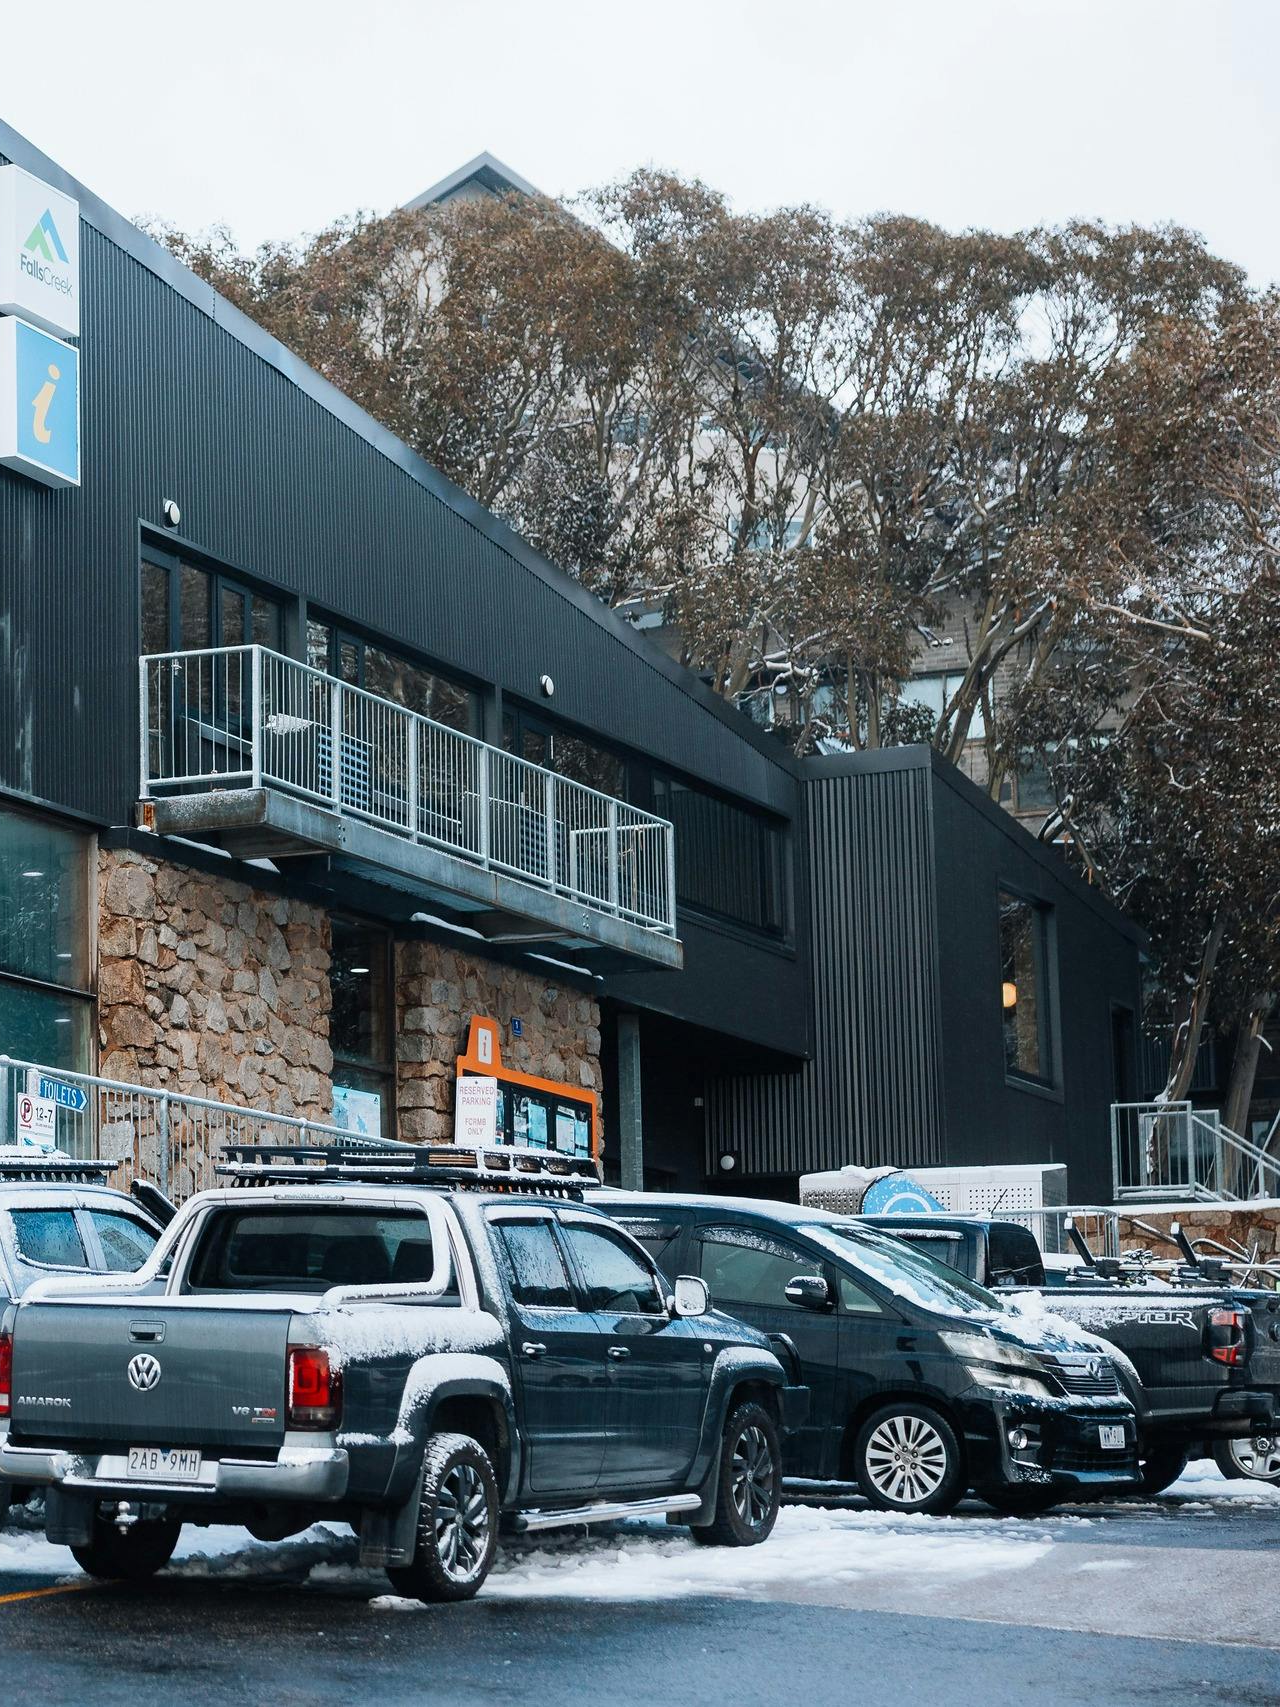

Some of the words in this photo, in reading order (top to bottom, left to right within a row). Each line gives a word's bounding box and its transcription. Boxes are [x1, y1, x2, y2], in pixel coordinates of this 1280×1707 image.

[20, 253, 73, 298] FallsCreek
[43, 1080, 77, 1107] TOILETS
[460, 1086, 494, 1095] RESERVED
[462, 1097, 491, 1106] PARKING
[467, 1127, 484, 1136] ONLY
[17, 1396, 72, 1408] AMAROK
[231, 1406, 250, 1416] V6
[130, 1451, 159, 1470] 2AB
[169, 1452, 199, 1472] 9MH
